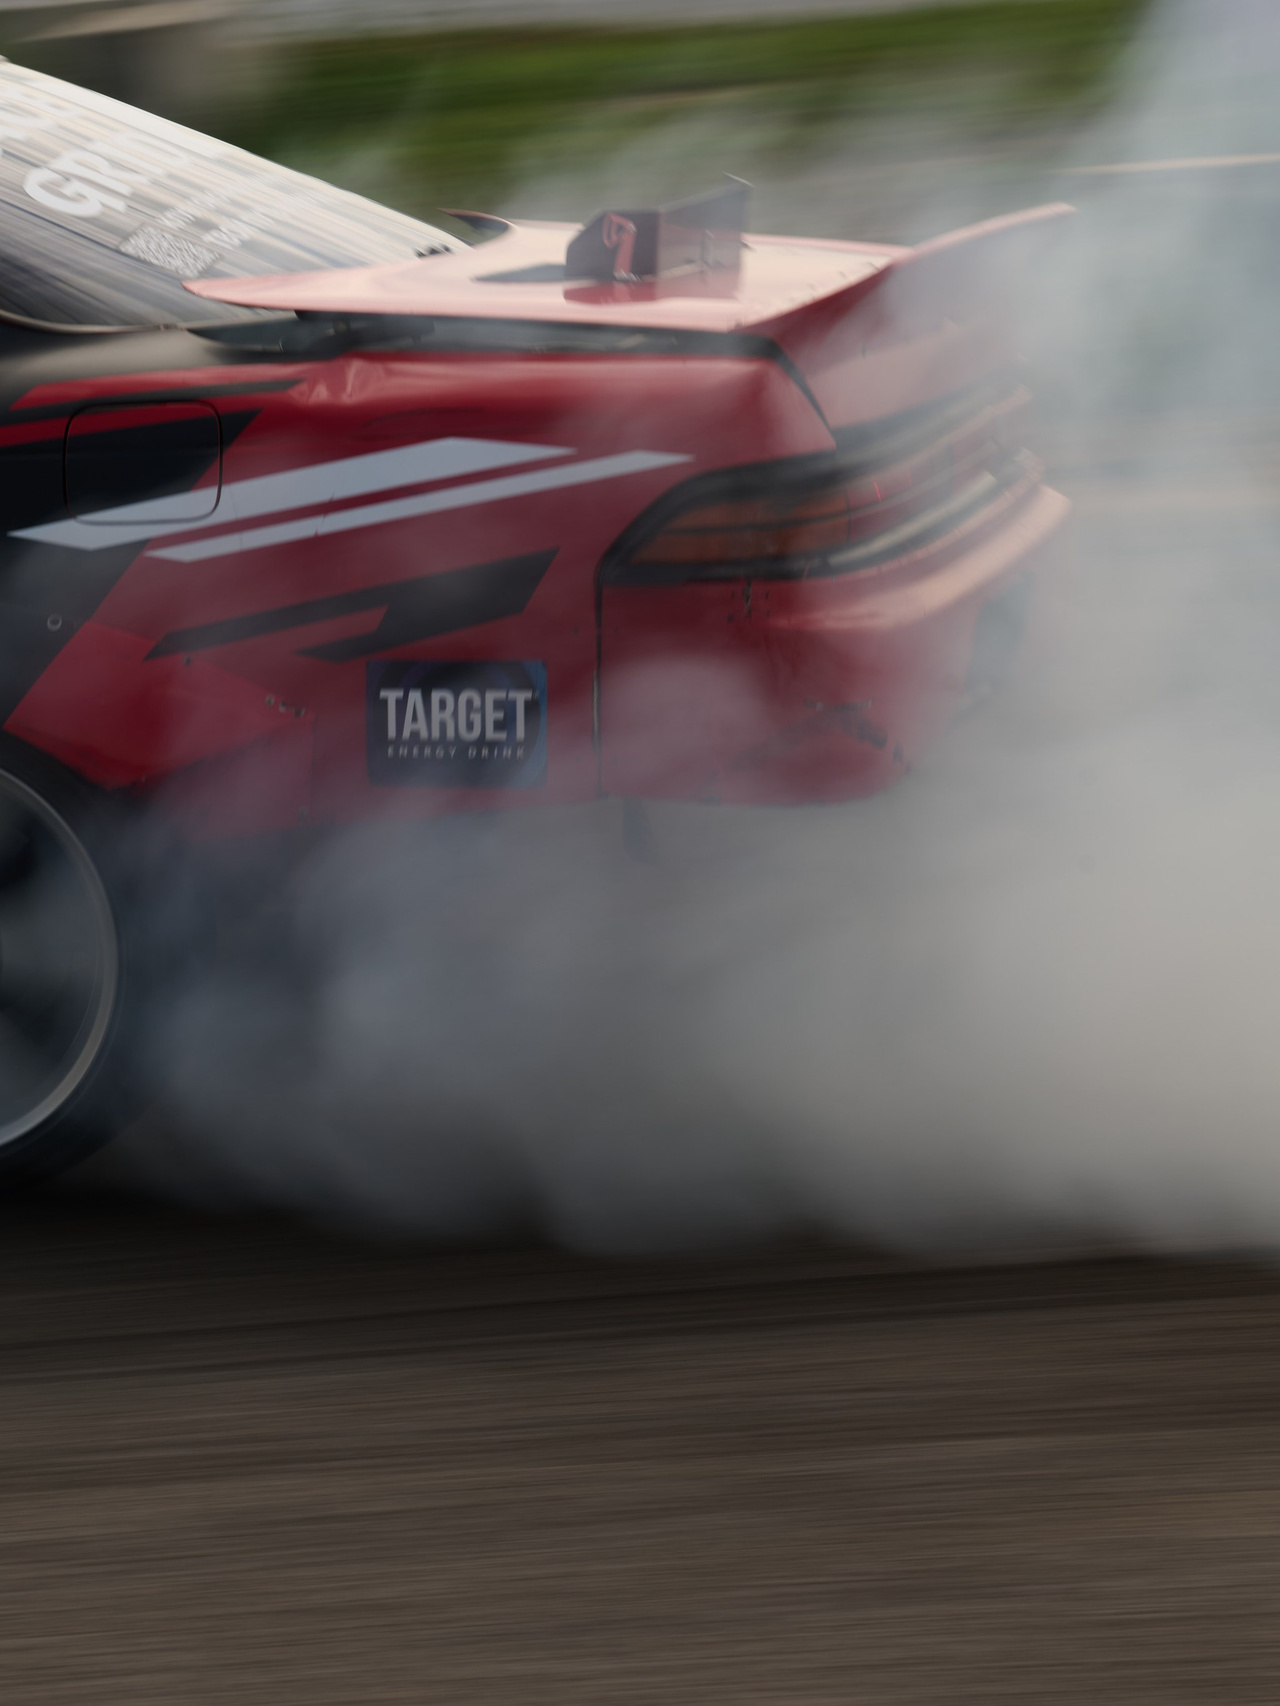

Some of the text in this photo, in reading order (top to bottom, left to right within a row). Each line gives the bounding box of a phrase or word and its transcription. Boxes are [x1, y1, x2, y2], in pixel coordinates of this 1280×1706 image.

[379, 687, 533, 742] TARGET
[387, 745, 525, 759] ENERGY DRINK
